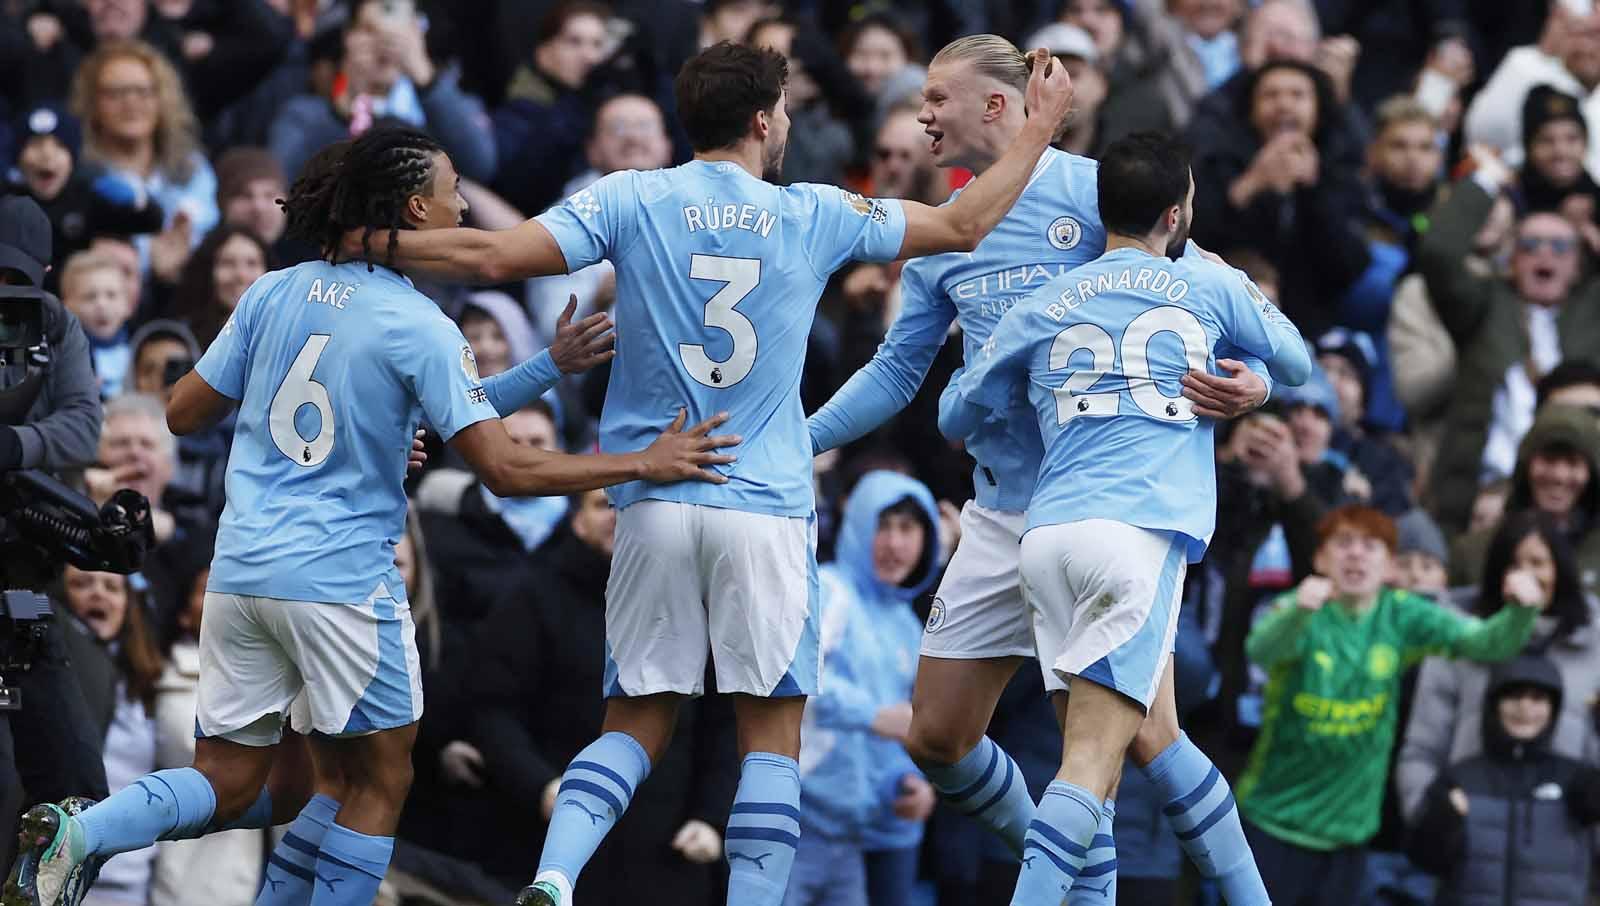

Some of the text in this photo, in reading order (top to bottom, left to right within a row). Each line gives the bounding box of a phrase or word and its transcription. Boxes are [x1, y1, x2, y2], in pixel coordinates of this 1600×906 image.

[683, 196, 777, 239] RÚBEN
[307, 278, 361, 309] AKÉ
[678, 253, 762, 389] 3
[1045, 267, 1189, 322] BERNARDO
[268, 333, 336, 467] 6
[1048, 305, 1209, 426] 20
